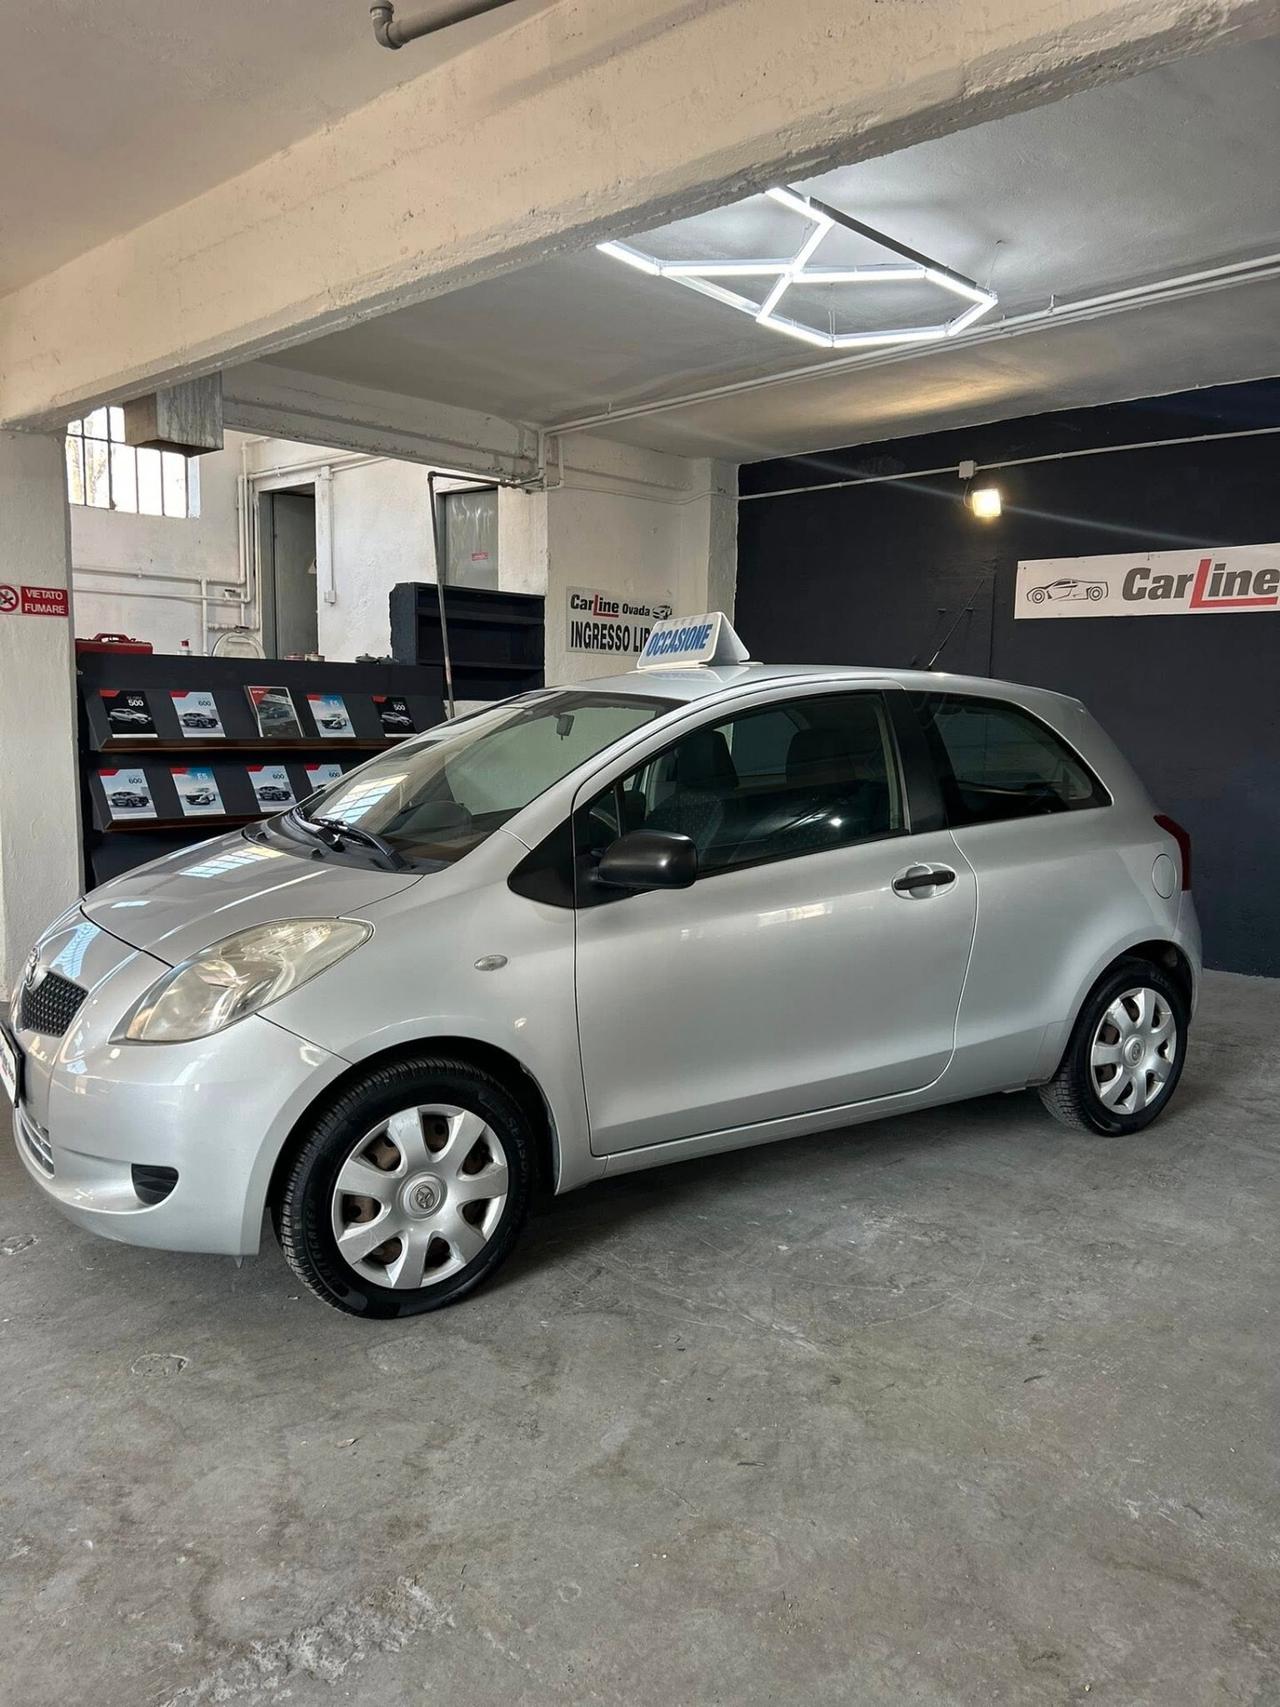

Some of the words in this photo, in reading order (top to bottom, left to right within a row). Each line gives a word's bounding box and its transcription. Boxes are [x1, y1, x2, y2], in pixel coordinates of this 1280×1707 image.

[1122, 558, 1280, 609] CarLine
[24, 602, 65, 614] FUMARE
[570, 594, 619, 618] CarLine
[622, 605, 651, 617] Ovada
[570, 621, 631, 651] INGRESSO
[645, 623, 713, 657] OCCASIONE
[128, 699, 144, 707] 500
